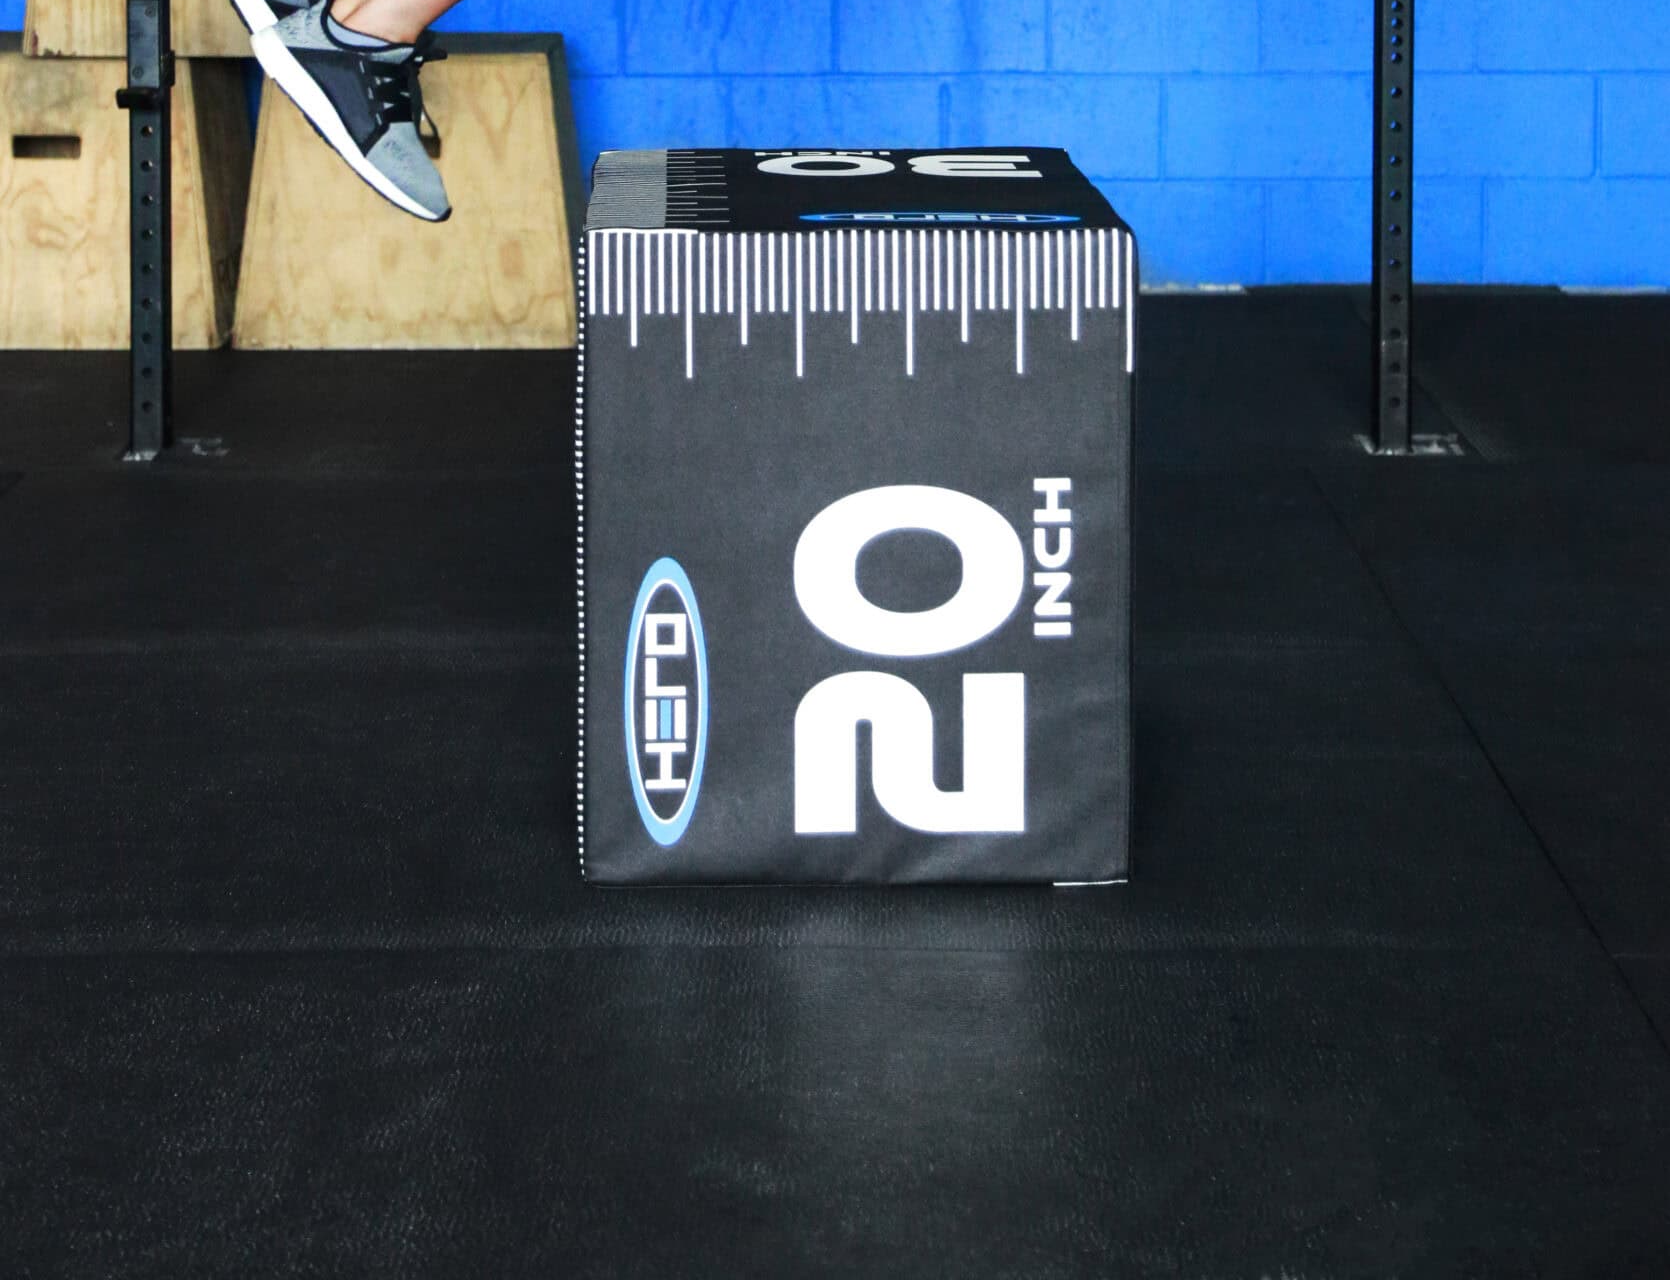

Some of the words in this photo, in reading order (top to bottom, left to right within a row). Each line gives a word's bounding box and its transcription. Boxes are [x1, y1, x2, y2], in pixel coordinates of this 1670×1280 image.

[757, 155, 1043, 178] 30
[1033, 477, 1073, 638] INCH
[793, 484, 1026, 835] 20
